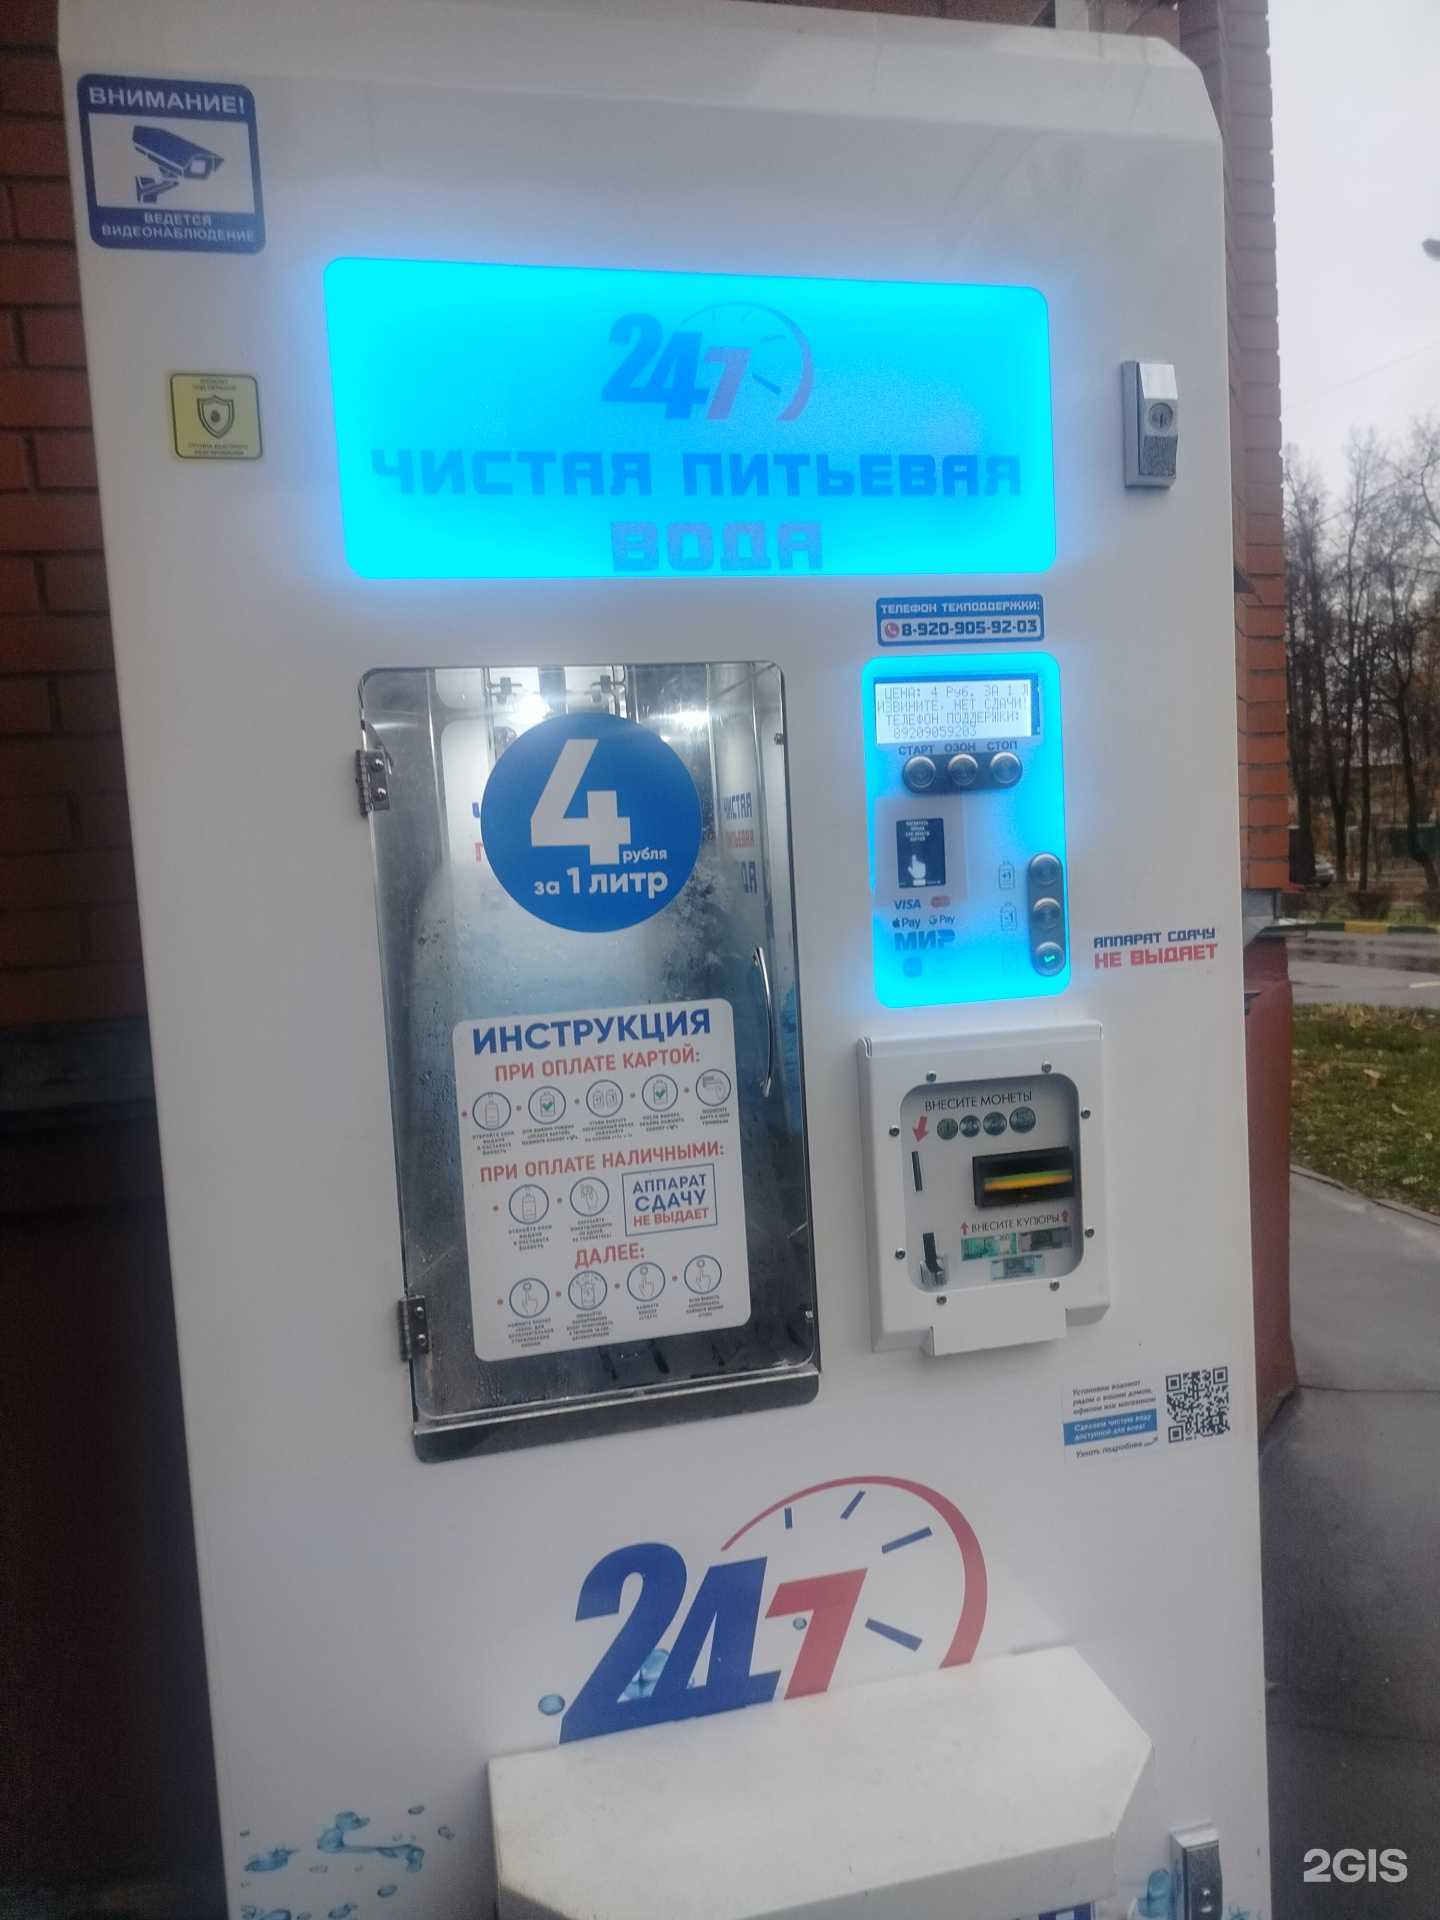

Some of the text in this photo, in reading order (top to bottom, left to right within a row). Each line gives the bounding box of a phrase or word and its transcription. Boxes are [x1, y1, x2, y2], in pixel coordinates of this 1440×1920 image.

[89, 87, 245, 115] ВНИМАНИЕ!
[144, 211, 212, 227] ВЕДЕТСЯ
[101, 225, 254, 242] ВИДЕОНАБЛЮДЕНИЕ
[373, 449, 1021, 497] ЧИСТАЯ ПИТЬЕВАЯ
[612, 521, 823, 571] ВОДА
[880, 603, 937, 615] ТЕЛЕФОН
[901, 619, 1038, 637] 8-920-905-92-03
[898, 740, 1018, 756] СТАРТ ОЗОН СТОП
[530, 738, 667, 865] 4 рубля
[534, 867, 669, 899] за 1 литр
[894, 899, 922, 910] VISA
[901, 917, 921, 929] Pay
[939, 914, 956, 926] Pay
[894, 929, 956, 951] МИР
[1093, 927, 1216, 949] АППАРАТ СДАЧУ
[1094, 943, 1218, 969] НЕ ВЫДАЕТ
[472, 1008, 712, 1056] ИНСТРУКЦИЯ
[495, 1043, 701, 1082] ПРИ ОПЛАТЕ КАРТОЙ:
[924, 1091, 1032, 1113] ВНЕСИТЕ МОНЕТЫ
[480, 1141, 725, 1182] ПРИ ОПЛАТЕ НАЛИЧНЫМИ:
[632, 1173, 708, 1194] АППАРАТ
[634, 1189, 707, 1213] СДАЧУ
[633, 1207, 710, 1227] НЕ ВЫДАЕТ
[971, 1219, 1014, 1233] ВНЕСИТЕ
[575, 1242, 645, 1269] ДАЛЕЕ:
